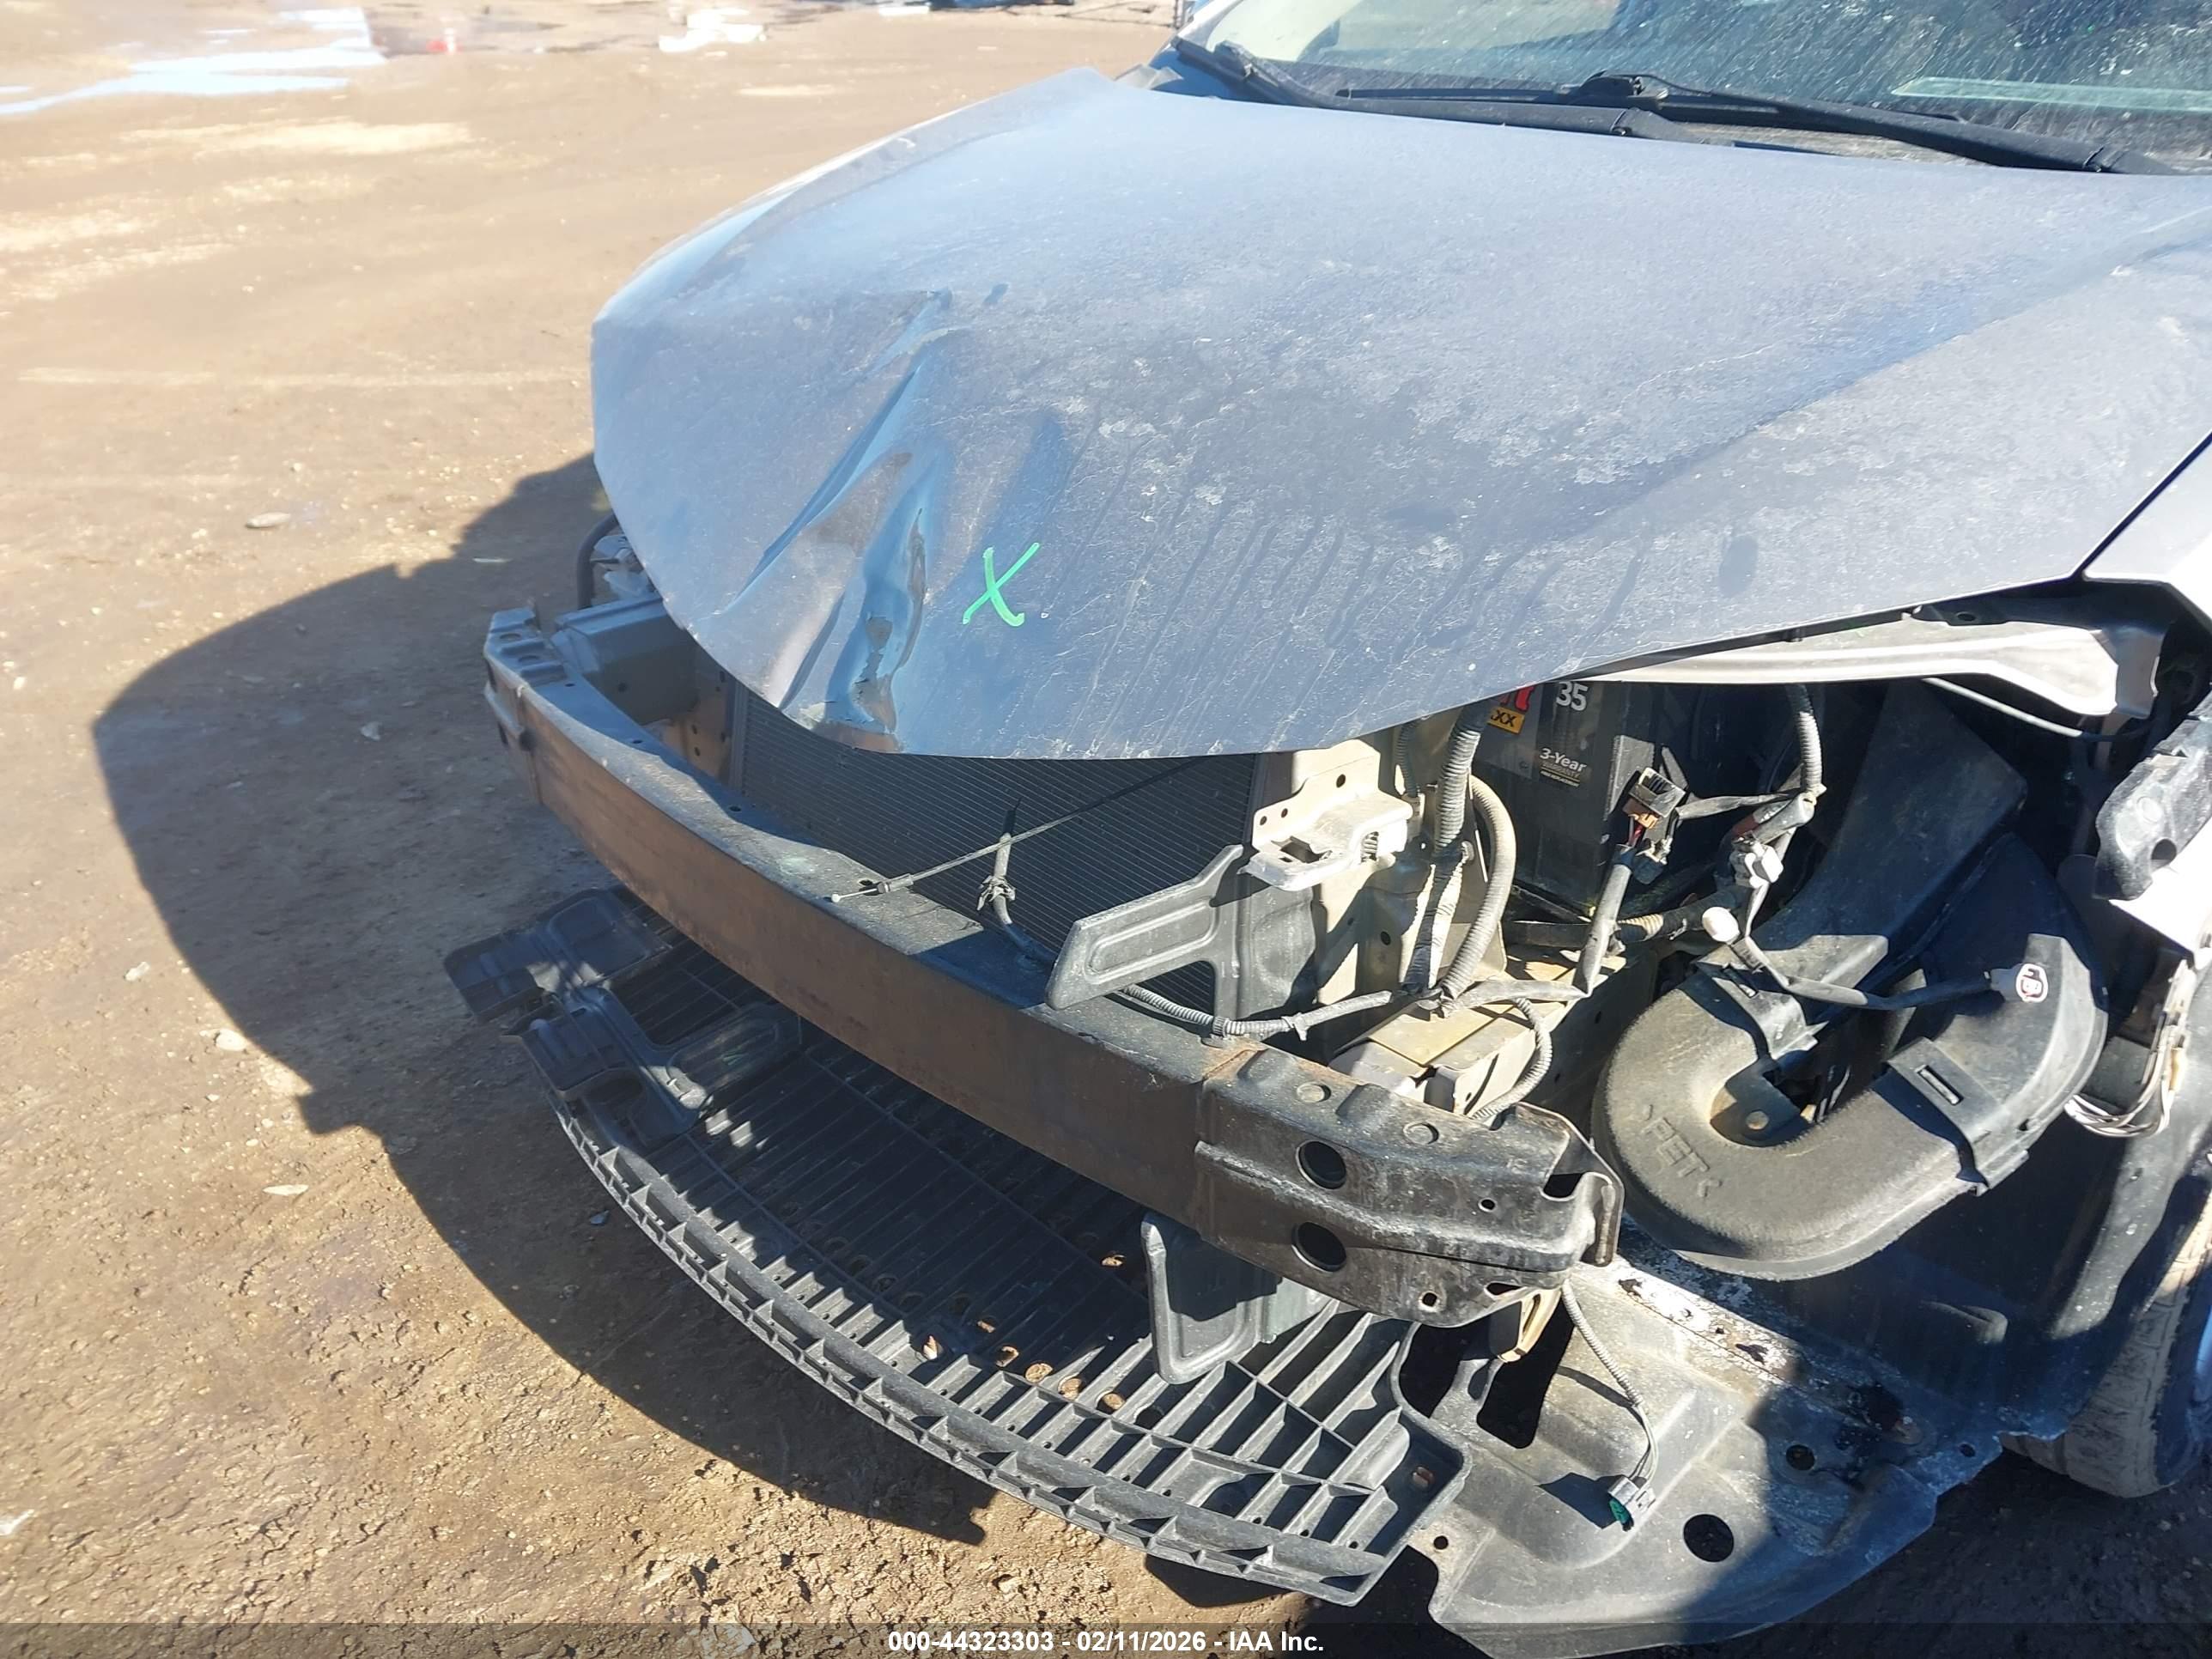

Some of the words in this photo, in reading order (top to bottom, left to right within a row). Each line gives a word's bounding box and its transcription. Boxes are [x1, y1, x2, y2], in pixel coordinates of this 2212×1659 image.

[963, 543, 1040, 626] X
[1555, 680, 1589, 711] 35
[1540, 747, 1587, 772] 3-Year
